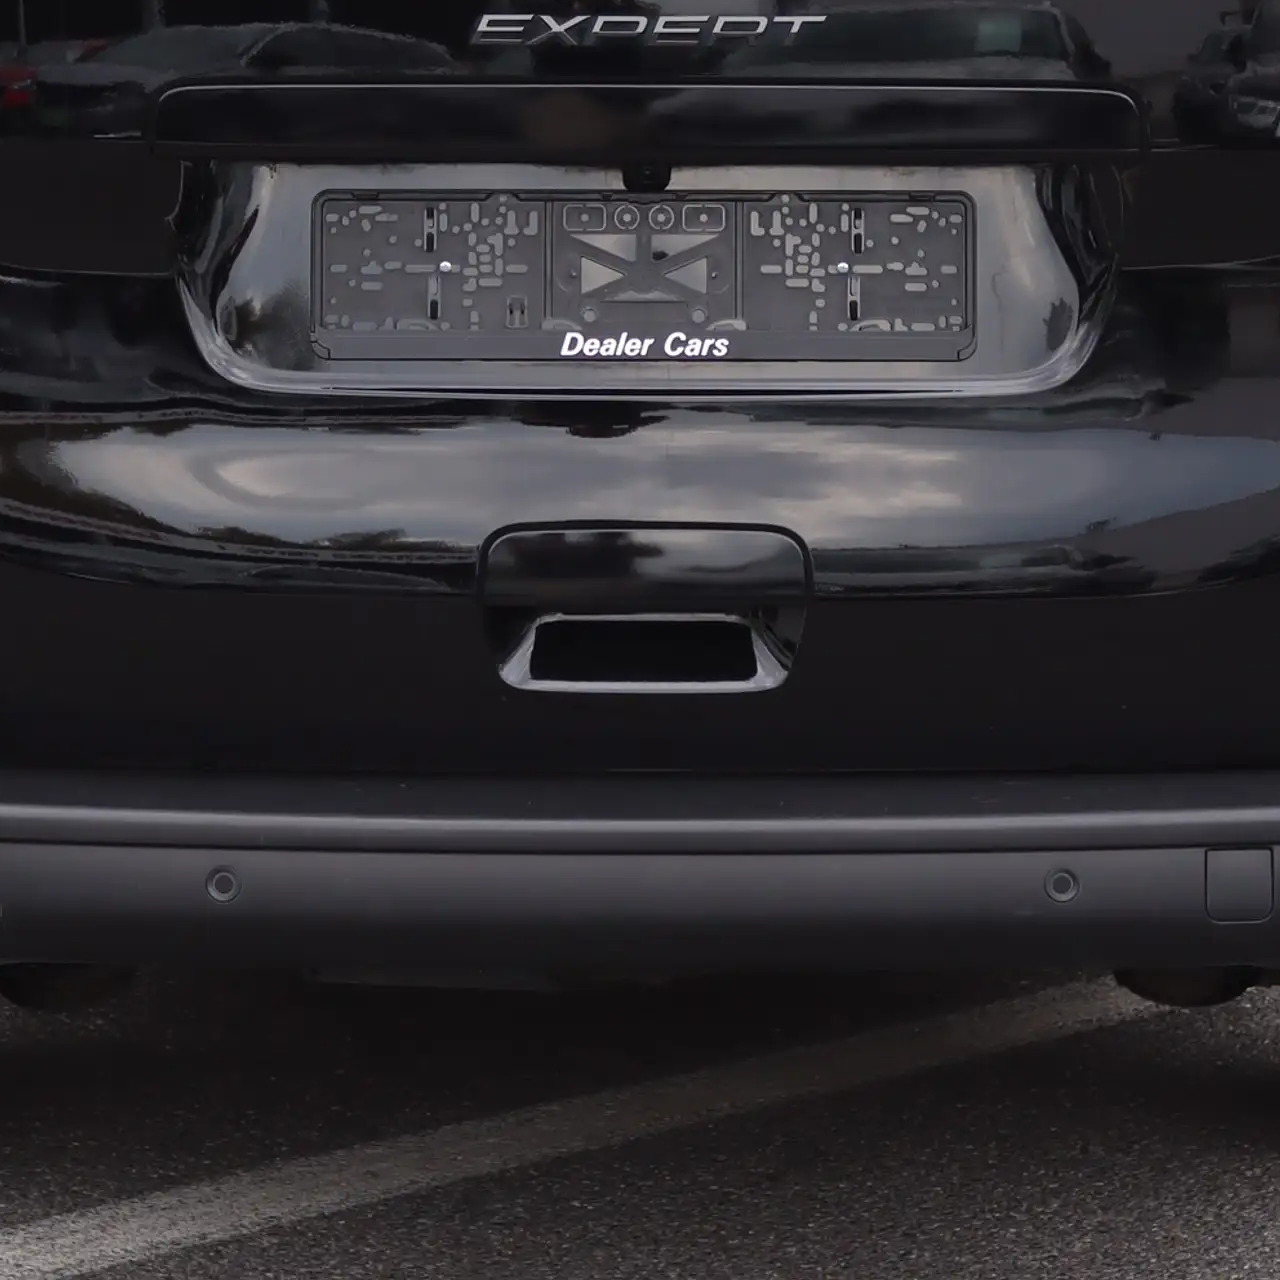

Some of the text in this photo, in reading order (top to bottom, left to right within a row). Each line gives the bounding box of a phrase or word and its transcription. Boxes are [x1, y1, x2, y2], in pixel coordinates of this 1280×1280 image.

[472, 13, 827, 46] EXPERT
[560, 331, 730, 357] Dealer Cars
